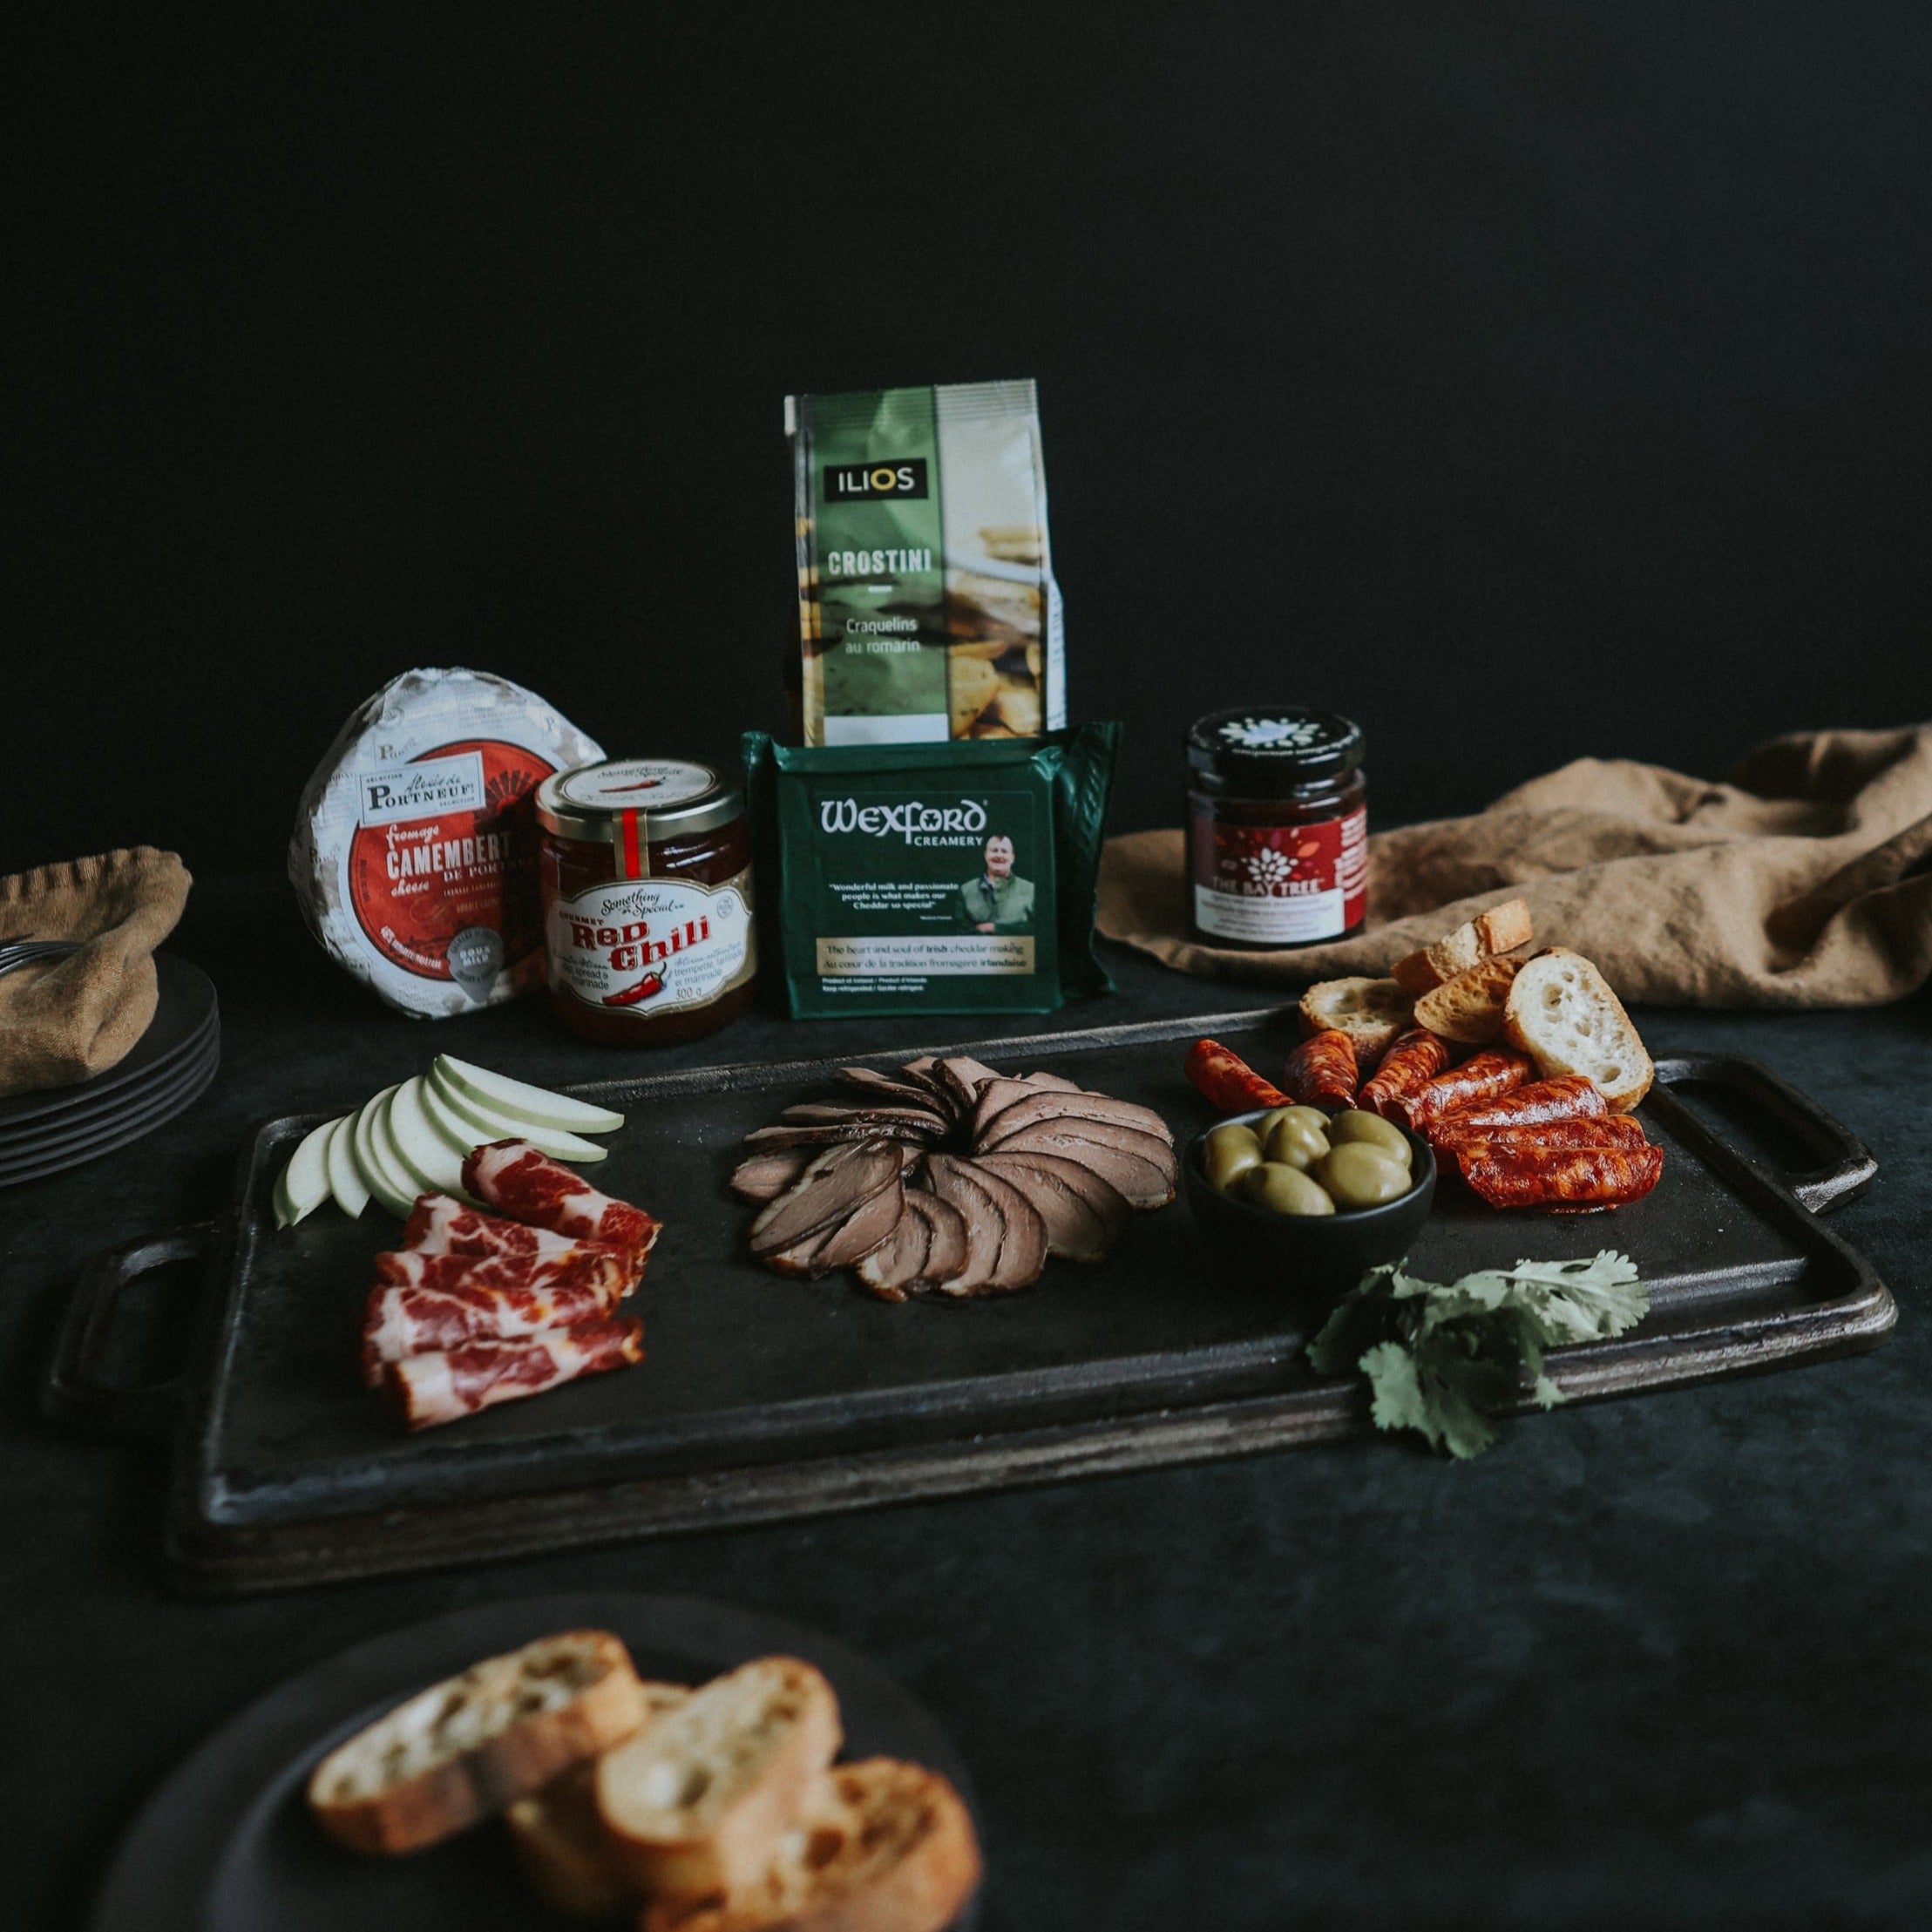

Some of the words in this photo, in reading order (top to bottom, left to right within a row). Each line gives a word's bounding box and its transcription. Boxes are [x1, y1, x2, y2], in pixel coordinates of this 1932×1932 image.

[838, 467, 915, 492] ILIOS
[828, 548, 931, 575] CROSTINI
[846, 615, 919, 635] Craquelins
[845, 641, 862, 654] au
[866, 639, 920, 654] romarin
[386, 824, 440, 851] fromage
[914, 836, 983, 846] CREAMERY
[387, 831, 512, 880] CAMEMBERT
[391, 878, 430, 897] cheese
[914, 882, 959, 892] passionate
[1243, 878, 1275, 896] BAY
[1279, 878, 1319, 896] TREE
[600, 888, 661, 916] Something
[841, 892, 871, 902] people
[853, 901, 889, 910] Cheddar
[633, 898, 674, 919] Special
[827, 946, 844, 954] The
[846, 945, 871, 954] heart
[874, 945, 890, 953] and
[892, 945, 911, 953] soul
[913, 945, 924, 953] of
[926, 944, 947, 953] Irish
[950, 944, 987, 953] cheddar
[989, 943, 1024, 955] making
[824, 960, 837, 969] Au
[864, 959, 877, 968] de
[980, 959, 1027, 967] irlandaise
[573, 976, 609, 990] marinade
[684, 968, 722, 985] marinade
